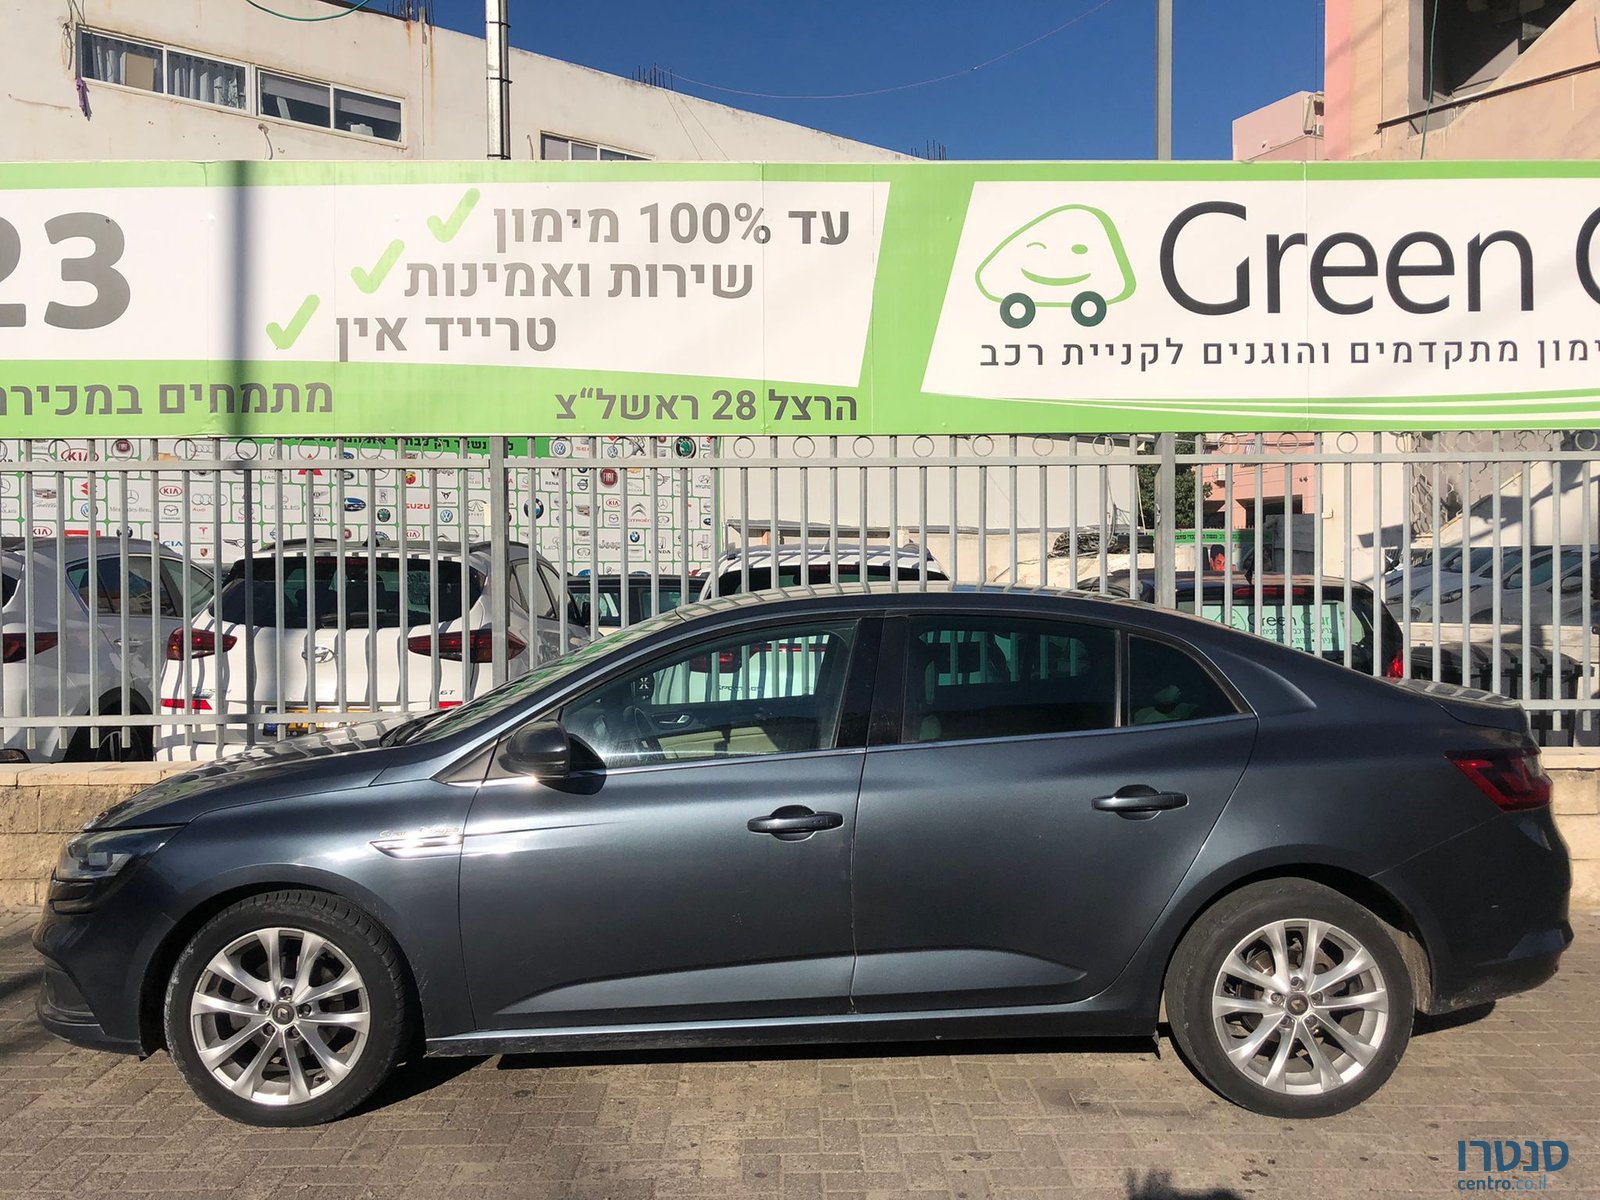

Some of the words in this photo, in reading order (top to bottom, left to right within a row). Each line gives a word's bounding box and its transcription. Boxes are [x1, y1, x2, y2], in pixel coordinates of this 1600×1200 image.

[493, 207, 619, 254] מימון
[640, 202, 772, 245] 100%
[788, 210, 850, 246] עד
[1160, 202, 1533, 315] Green
[404, 261, 591, 298] ואמינות
[608, 262, 753, 299] שירות
[335, 317, 408, 363] אין
[425, 316, 557, 352] טרייד
[980, 344, 1043, 366] רכב
[1061, 337, 1184, 373] לקניית
[1203, 342, 1329, 366] והוגנים
[1351, 340, 1518, 370] מתקדמים
[1536, 339, 1600, 370] ימון
[159, 382, 334, 415] מתמחים
[712, 389, 757, 421] 28
[768, 388, 857, 421] הרצל
[163, 487, 179, 495] KIA
